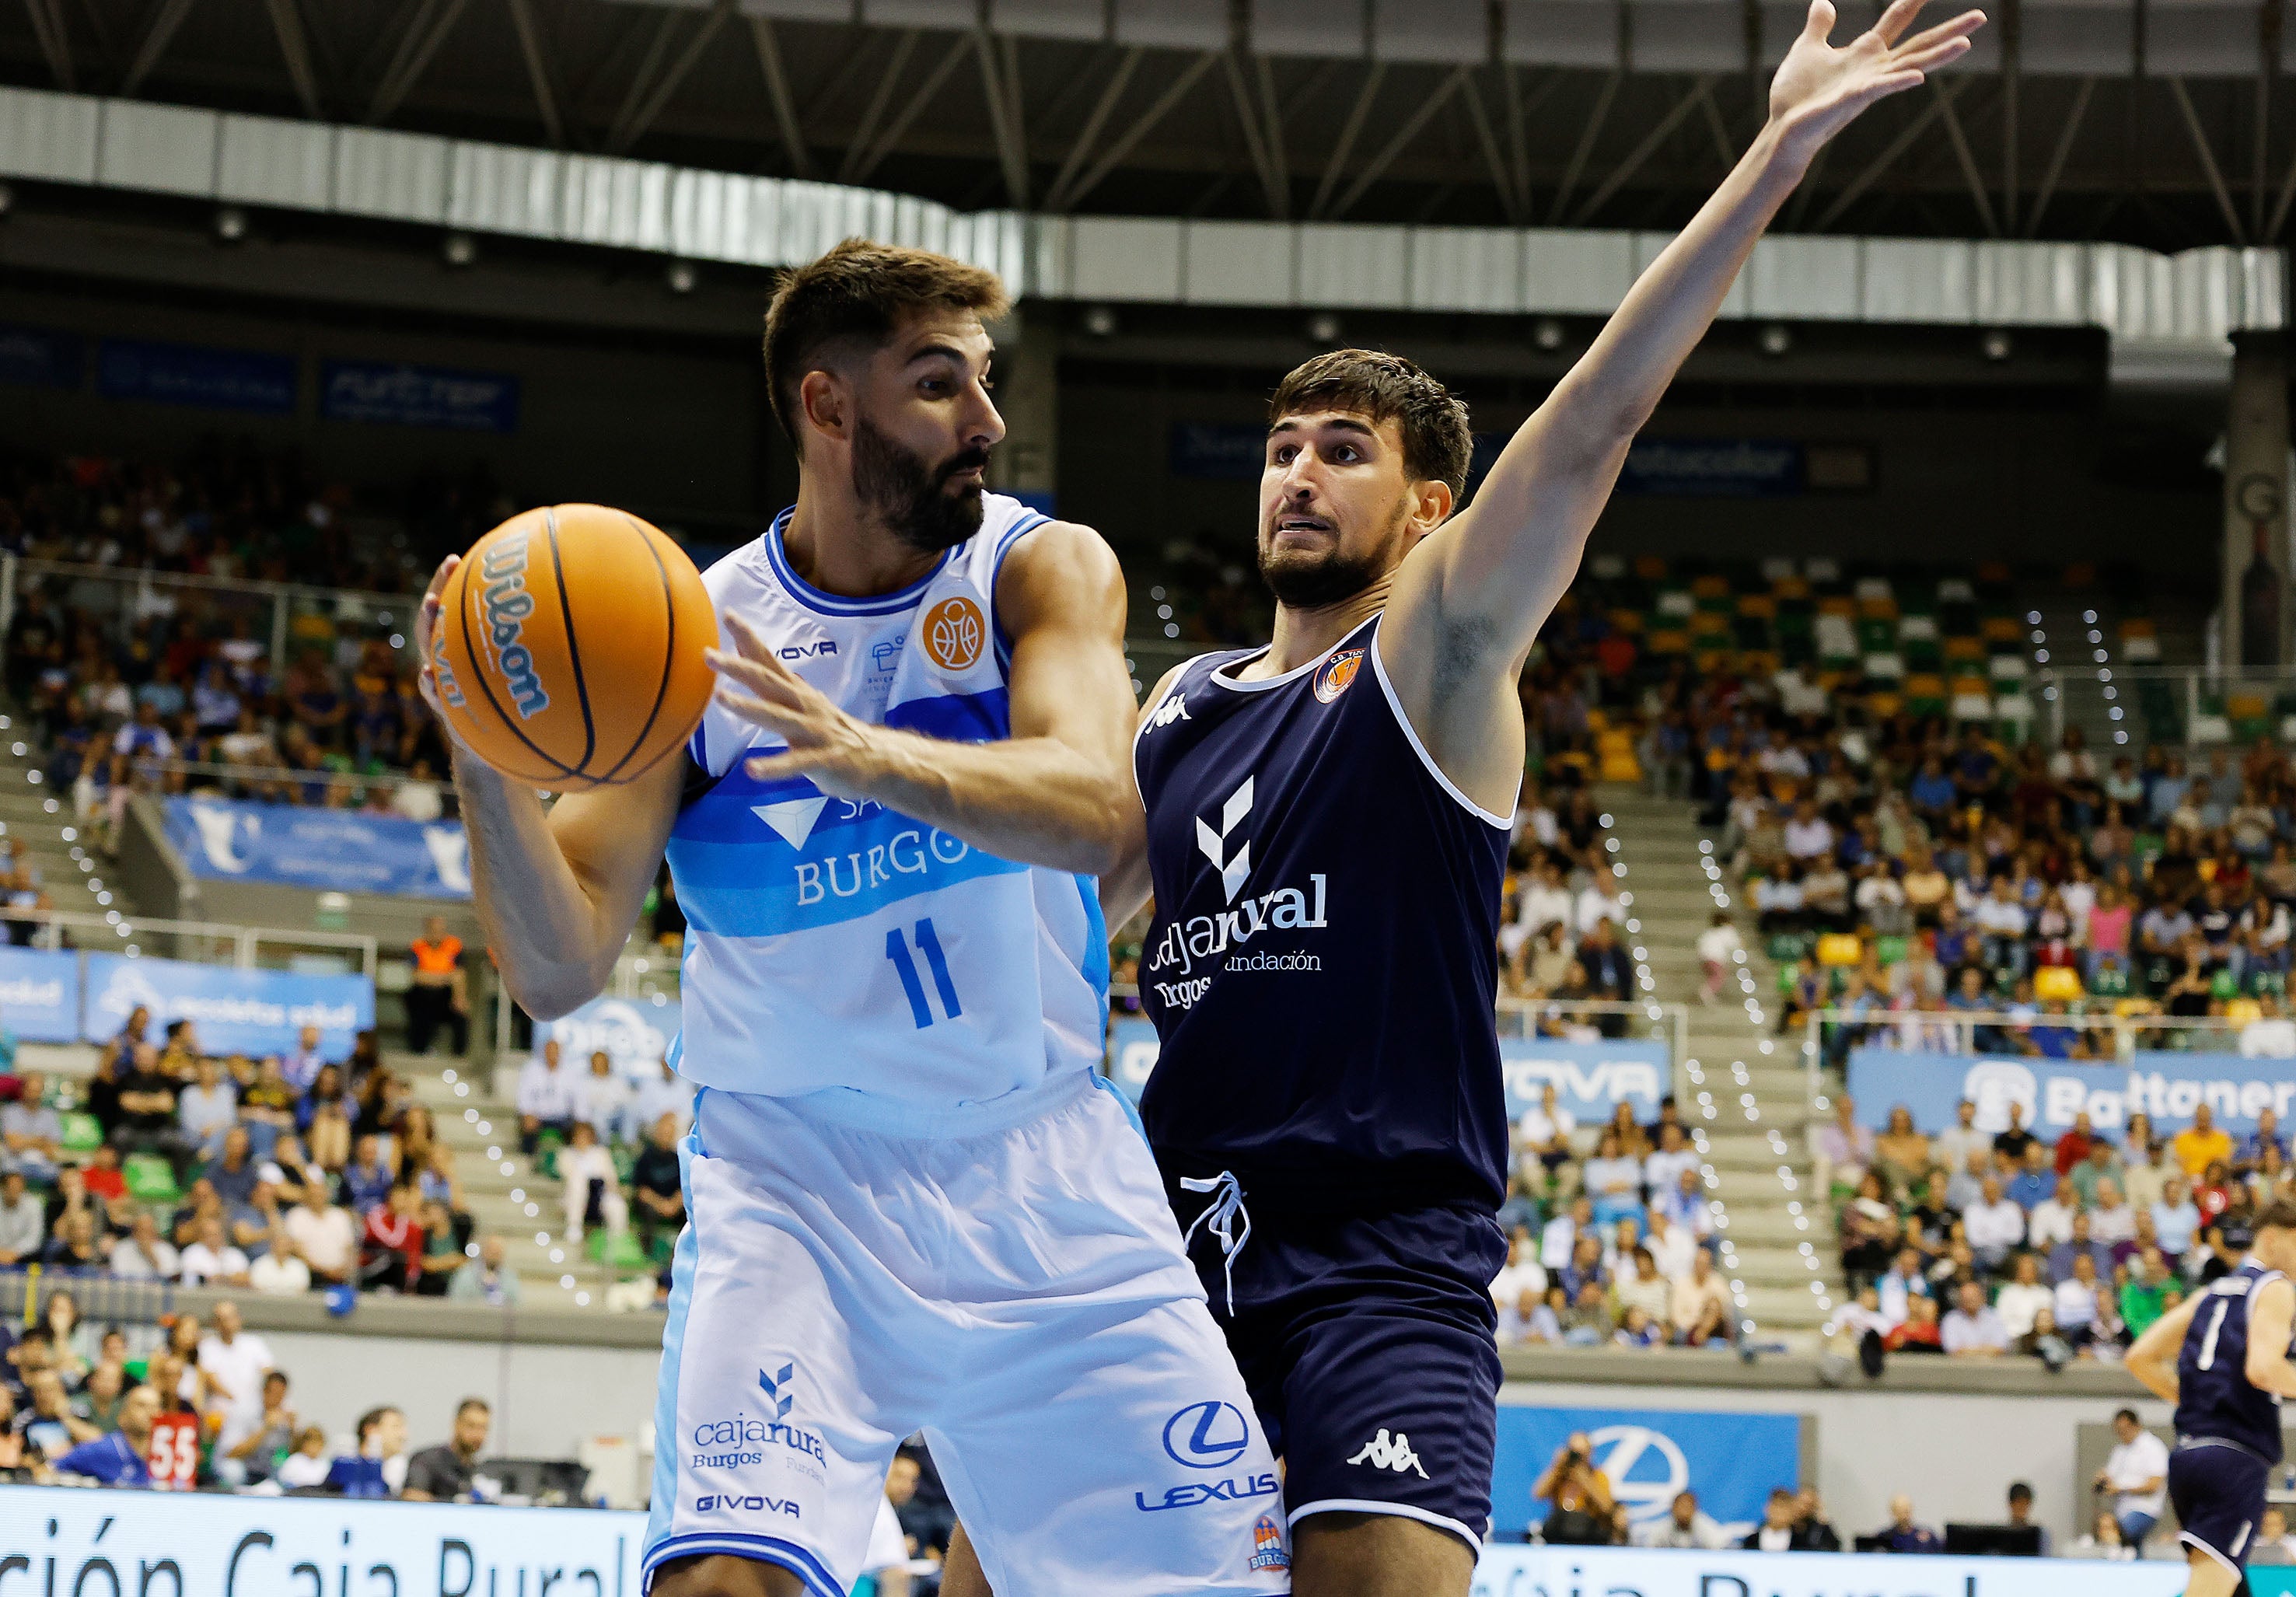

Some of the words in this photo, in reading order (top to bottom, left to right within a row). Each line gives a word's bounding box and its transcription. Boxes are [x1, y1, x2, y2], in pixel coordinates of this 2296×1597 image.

[481, 529, 550, 720] Wilson
[838, 796, 886, 820] SA
[794, 827, 983, 907] BURGO
[886, 917, 963, 1029] 11
[1223, 949, 1322, 972] undación
[149, 1424, 197, 1480] 55
[692, 1452, 762, 1469] Burgos
[694, 1412, 827, 1469] cajarura
[696, 1494, 800, 1518] GIVOVA
[1134, 1473, 1279, 1512] LEXUS
